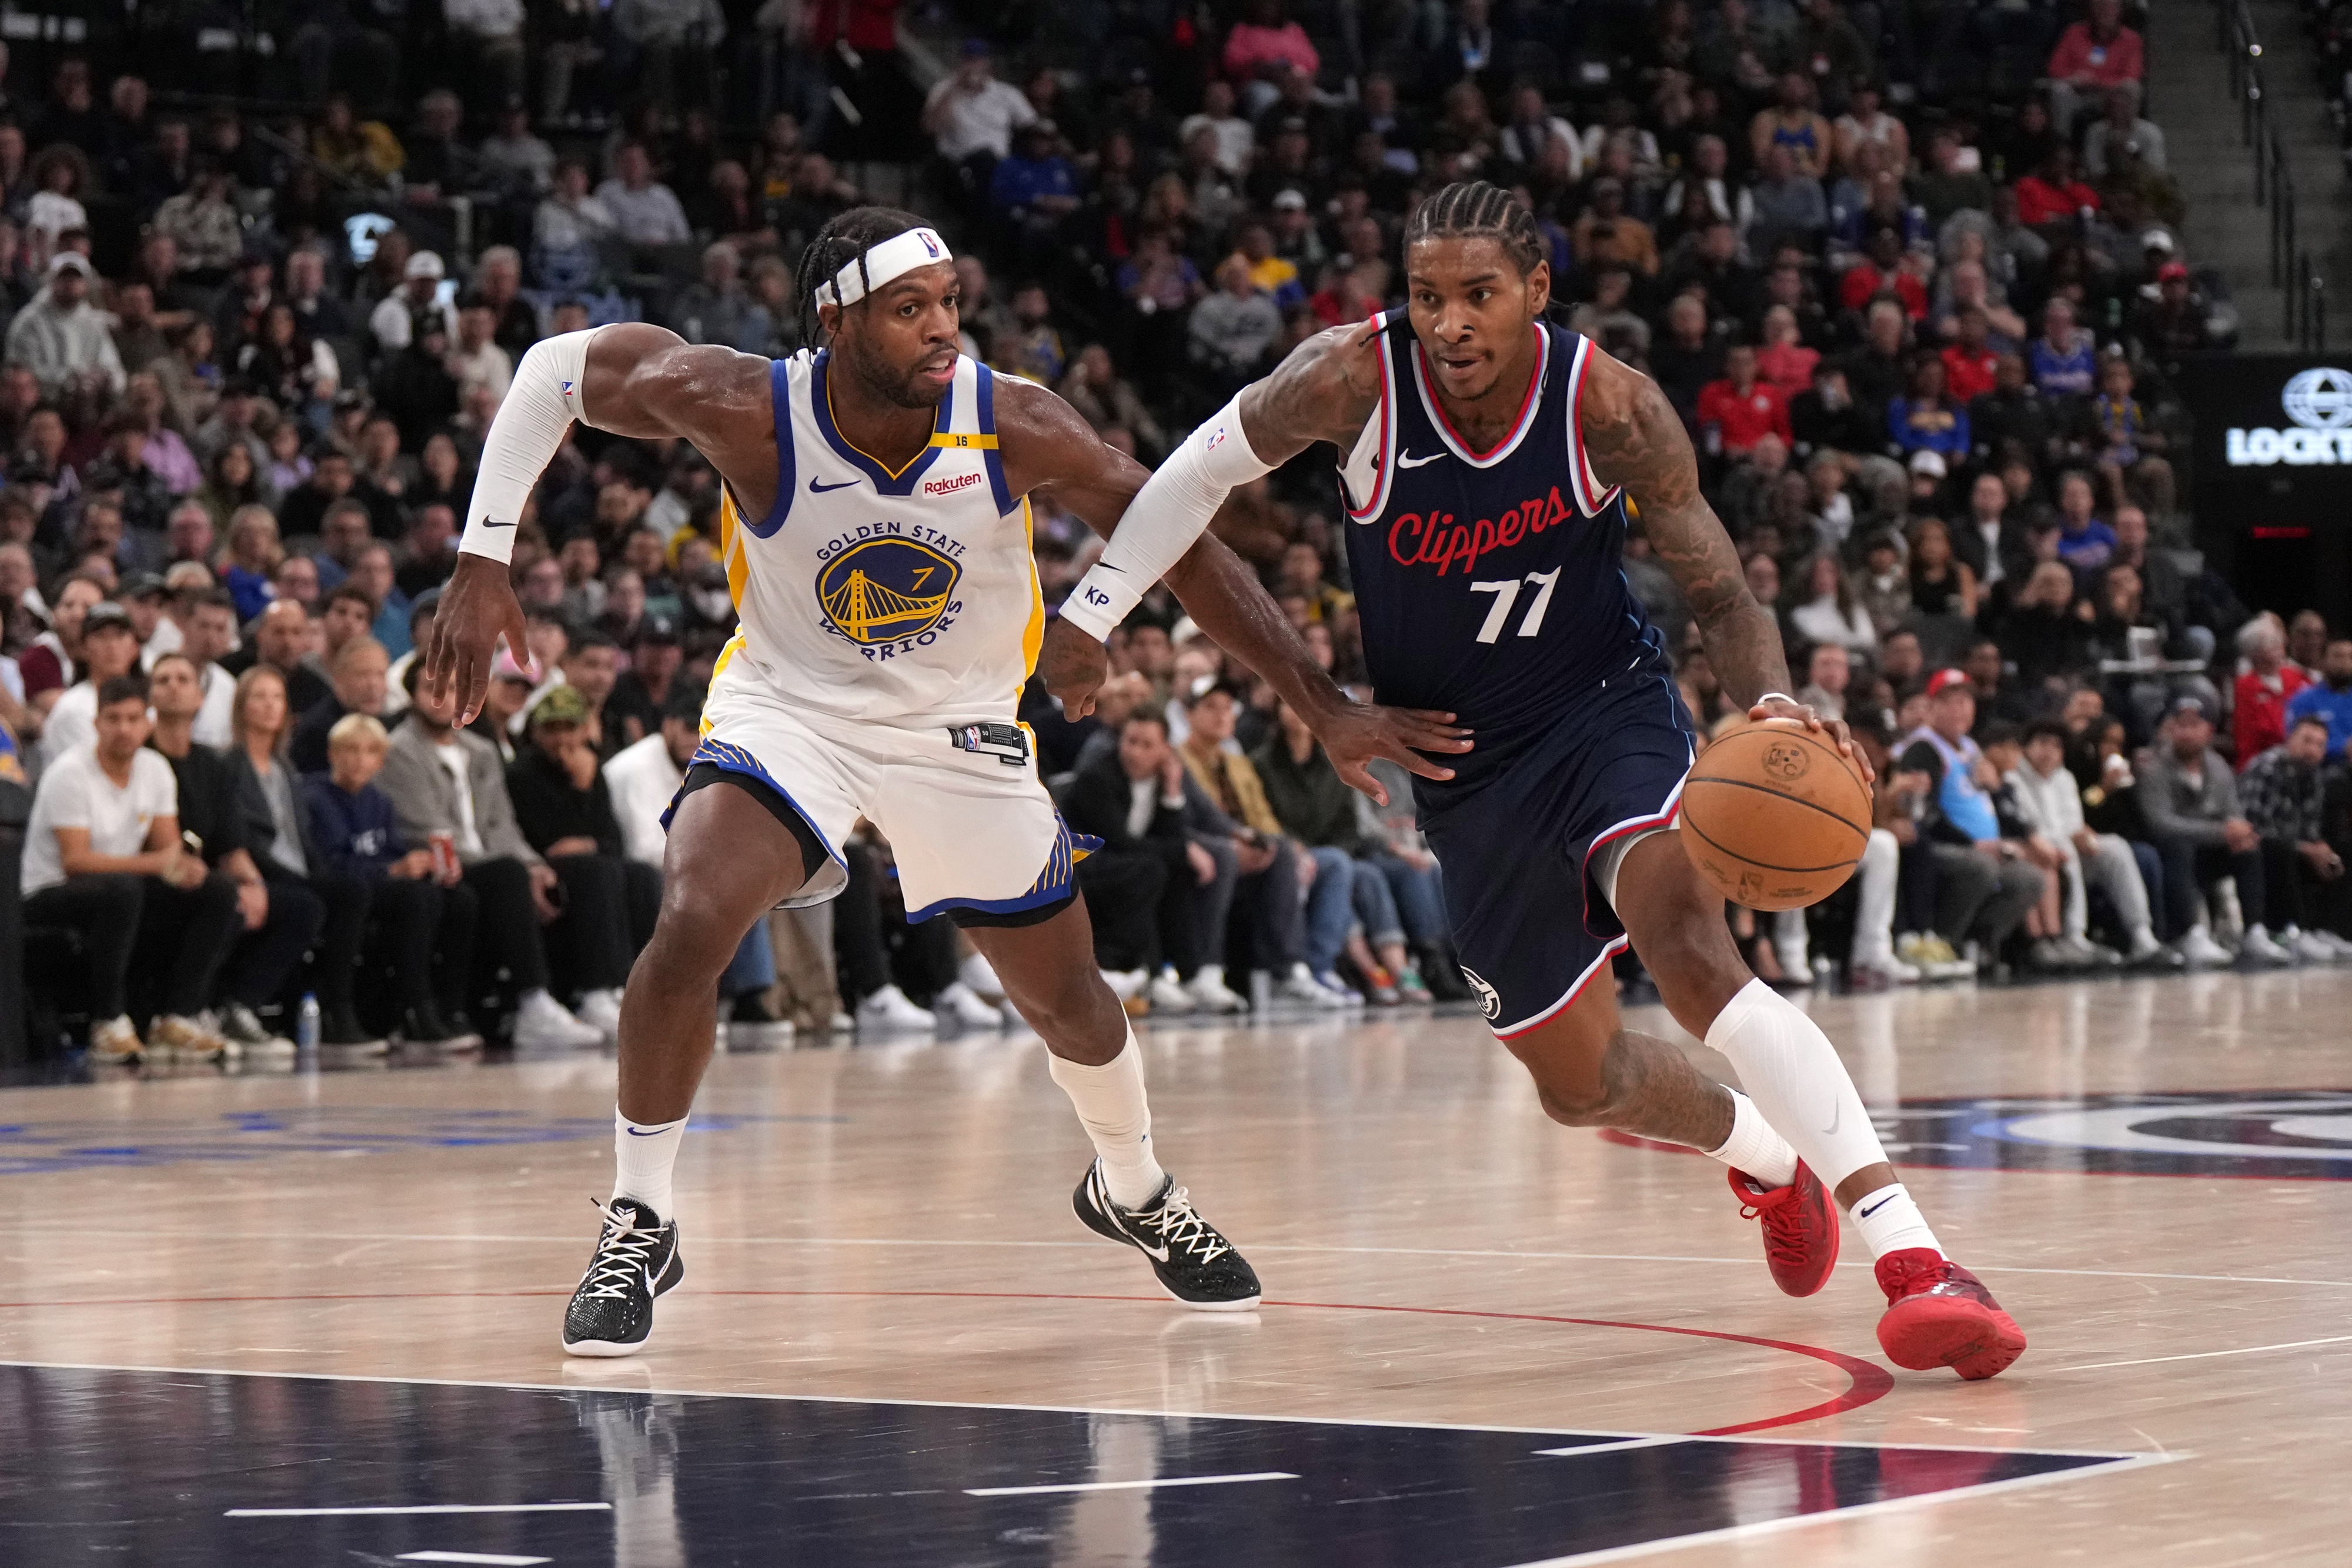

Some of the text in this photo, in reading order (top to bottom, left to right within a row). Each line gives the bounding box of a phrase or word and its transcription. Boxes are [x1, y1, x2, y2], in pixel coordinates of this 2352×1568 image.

[956, 436, 967, 446] 16
[924, 473, 981, 494] Rakuten
[817, 522, 967, 560] GOLDEN STATE
[1388, 486, 1572, 576] Clippers
[912, 567, 935, 591] 7
[1085, 586, 1110, 607] KP
[1470, 565, 1562, 644] 77
[819, 600, 963, 662] WRRIORS
